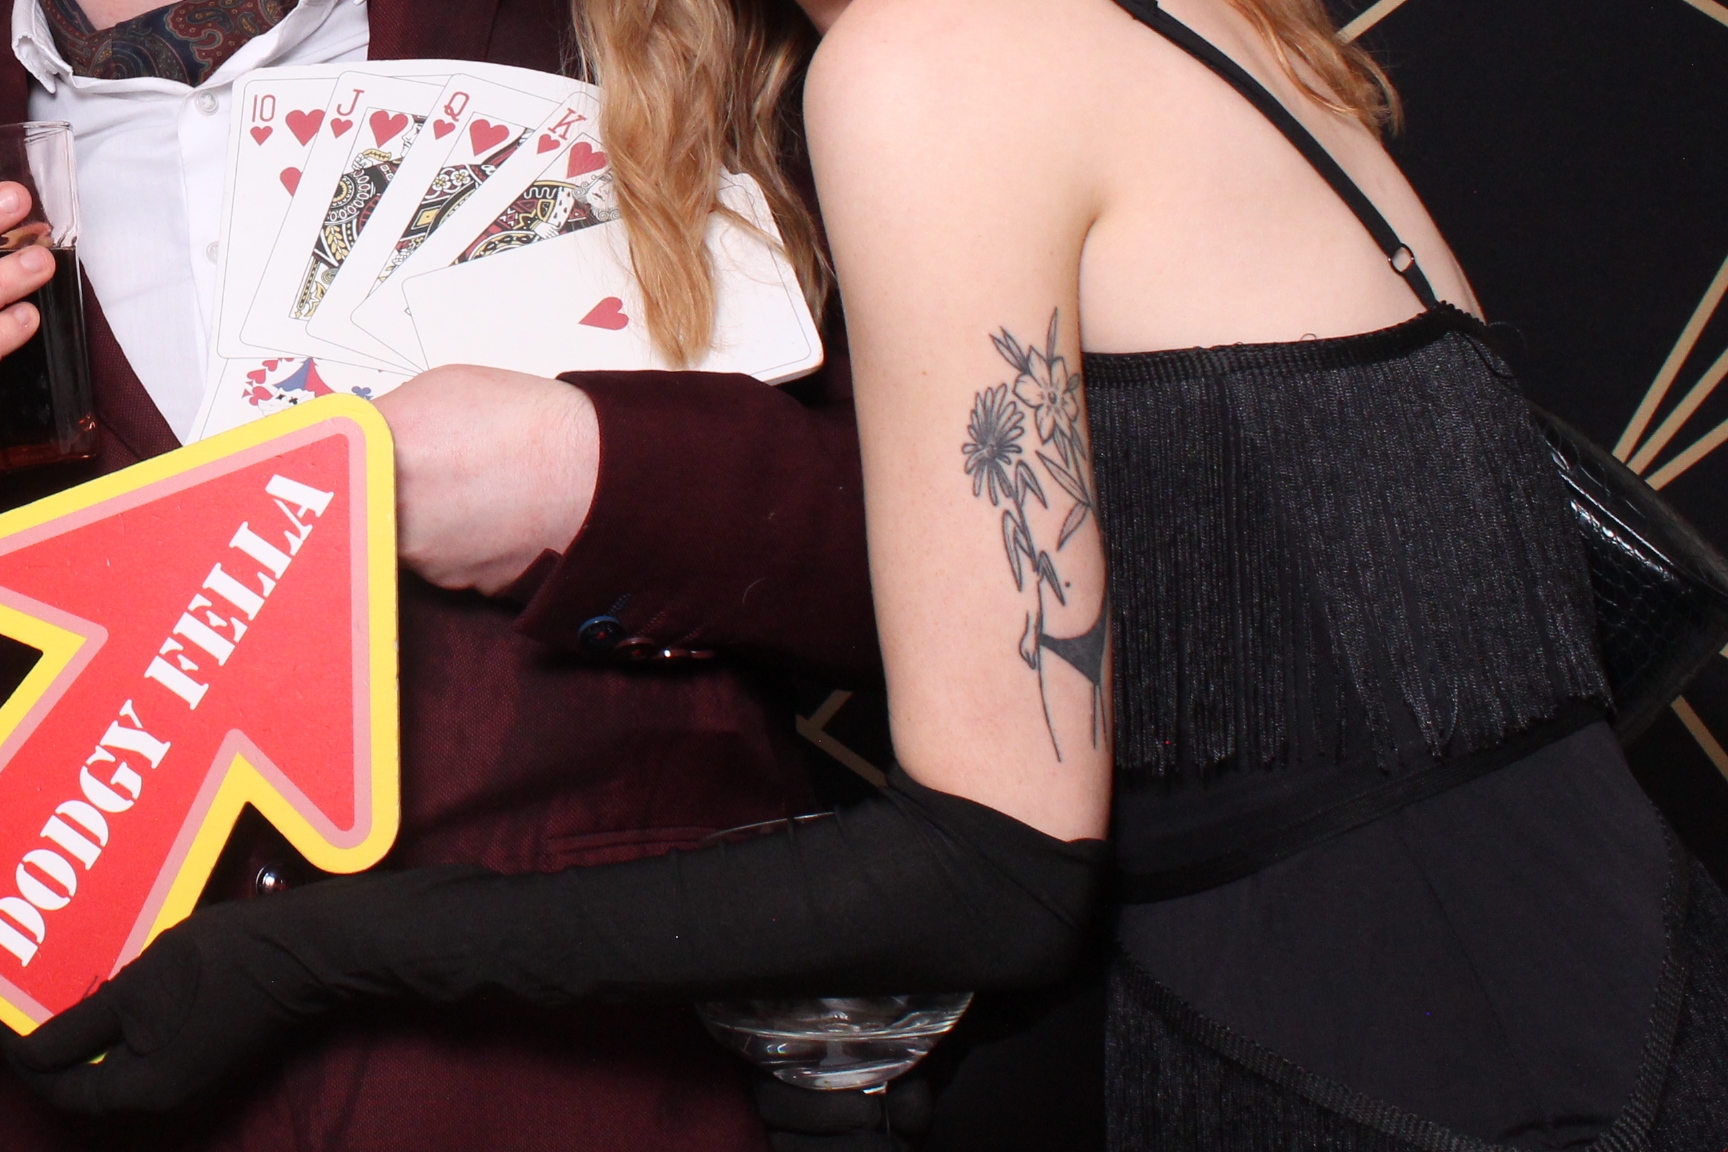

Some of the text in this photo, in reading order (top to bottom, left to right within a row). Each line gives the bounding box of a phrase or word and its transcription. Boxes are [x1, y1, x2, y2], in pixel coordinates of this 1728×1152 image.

[252, 94, 276, 123] 10
[336, 88, 365, 117] J
[443, 91, 470, 122] Q
[547, 107, 588, 140] K
[143, 473, 335, 711] FELLA
